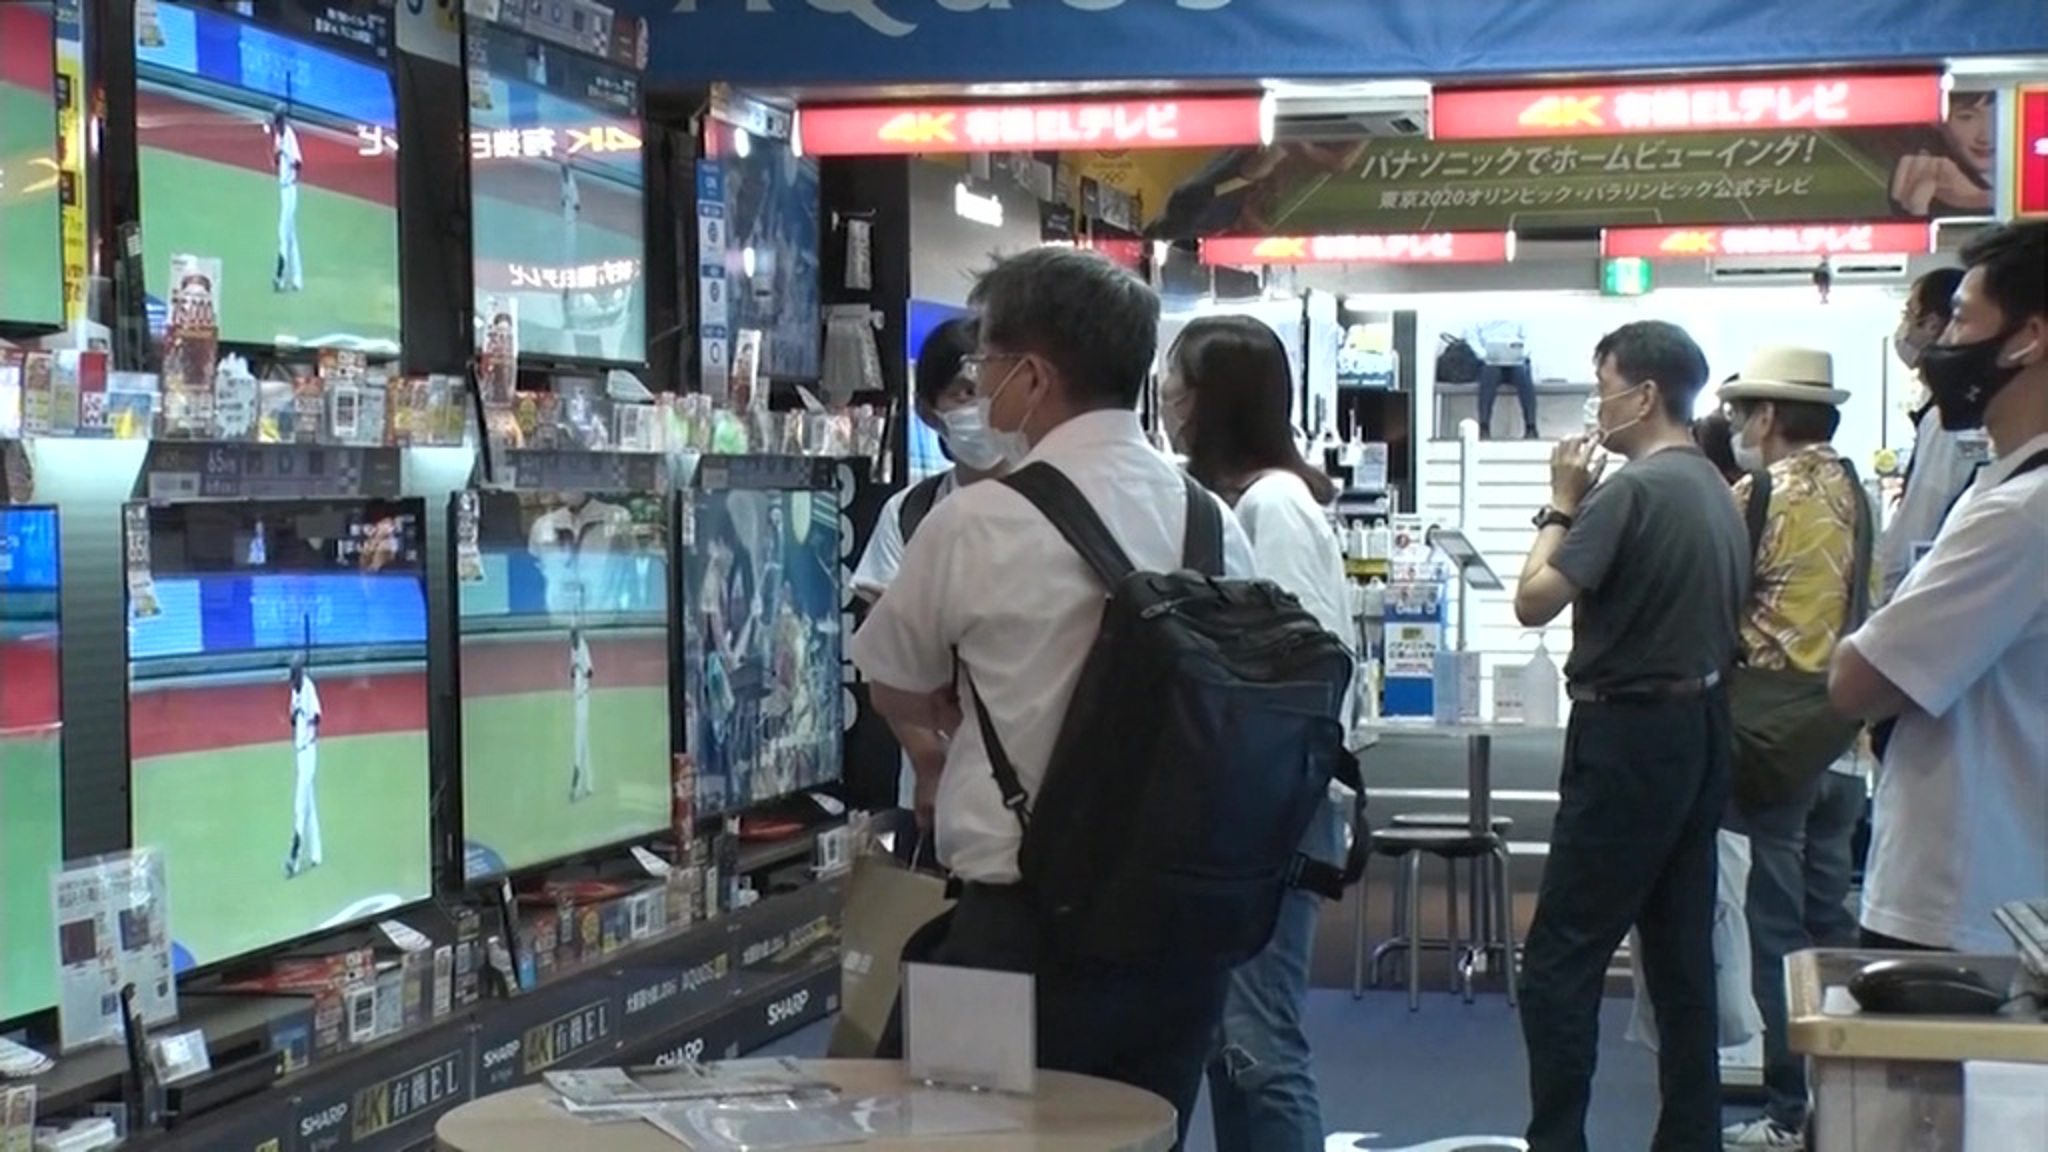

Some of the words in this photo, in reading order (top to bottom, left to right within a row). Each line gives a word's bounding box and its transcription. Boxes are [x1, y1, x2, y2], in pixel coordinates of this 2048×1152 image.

[1518, 96, 1604, 127] 4K
[878, 113, 957, 143] 4K
[1660, 231, 1715, 253] 4K
[767, 989, 809, 1025] SHARP
[483, 1039, 521, 1068] SHARP
[301, 1102, 348, 1136] SHARP
